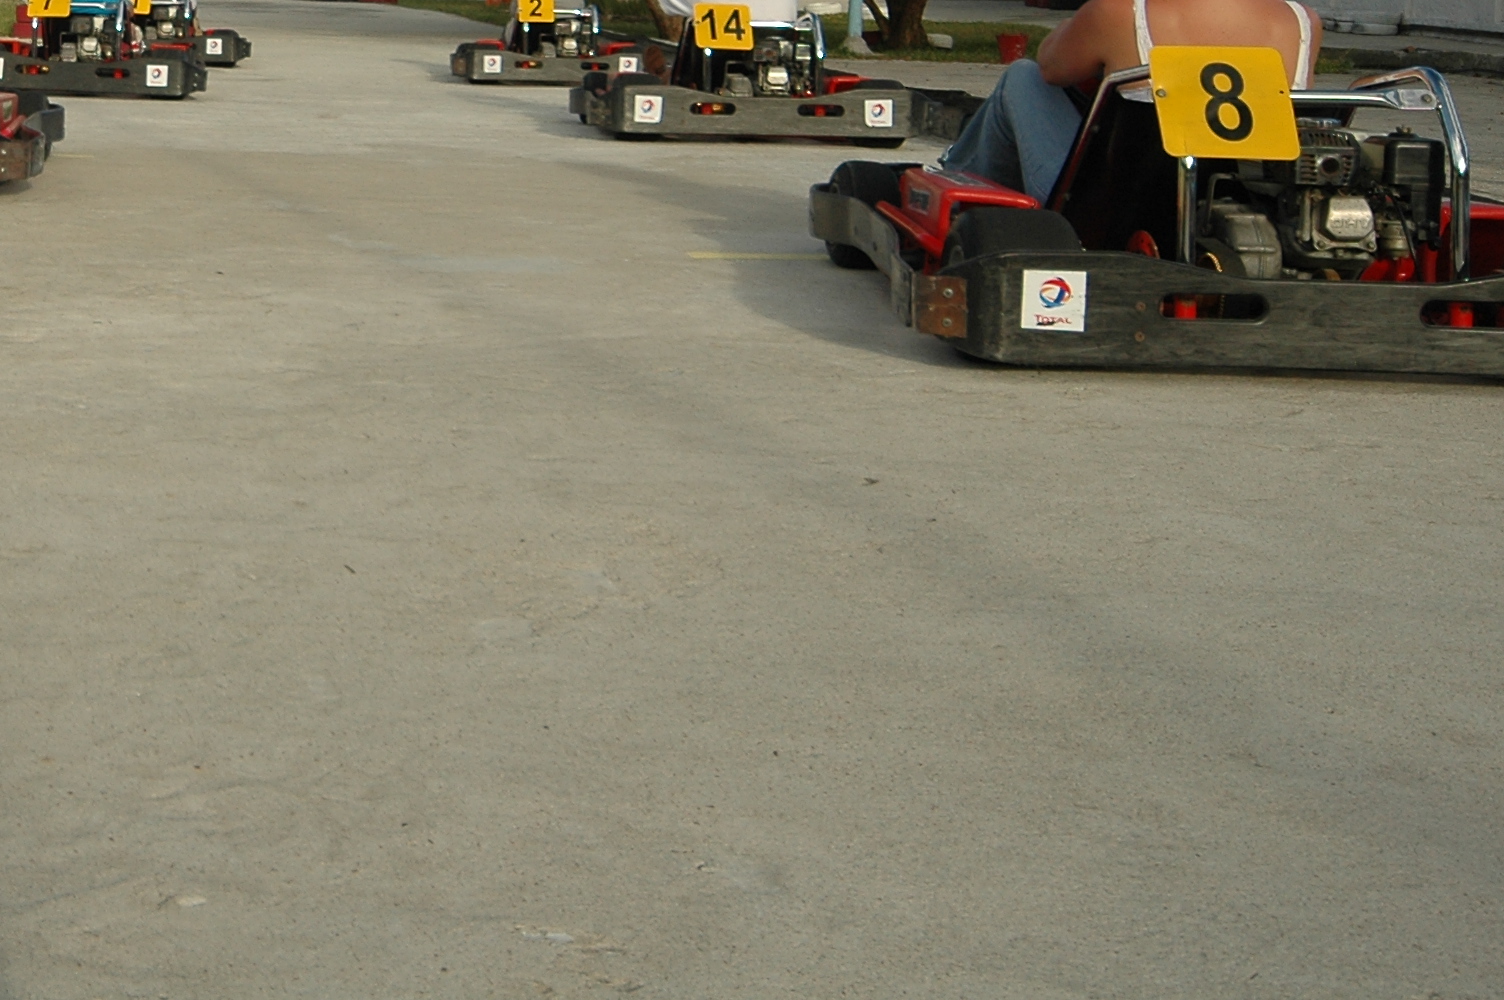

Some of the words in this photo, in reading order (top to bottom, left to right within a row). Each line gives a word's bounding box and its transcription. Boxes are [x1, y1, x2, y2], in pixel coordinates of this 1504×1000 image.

[701, 8, 746, 41] 14
[1199, 62, 1254, 142] 8
[1034, 314, 1073, 325] TOTAL
